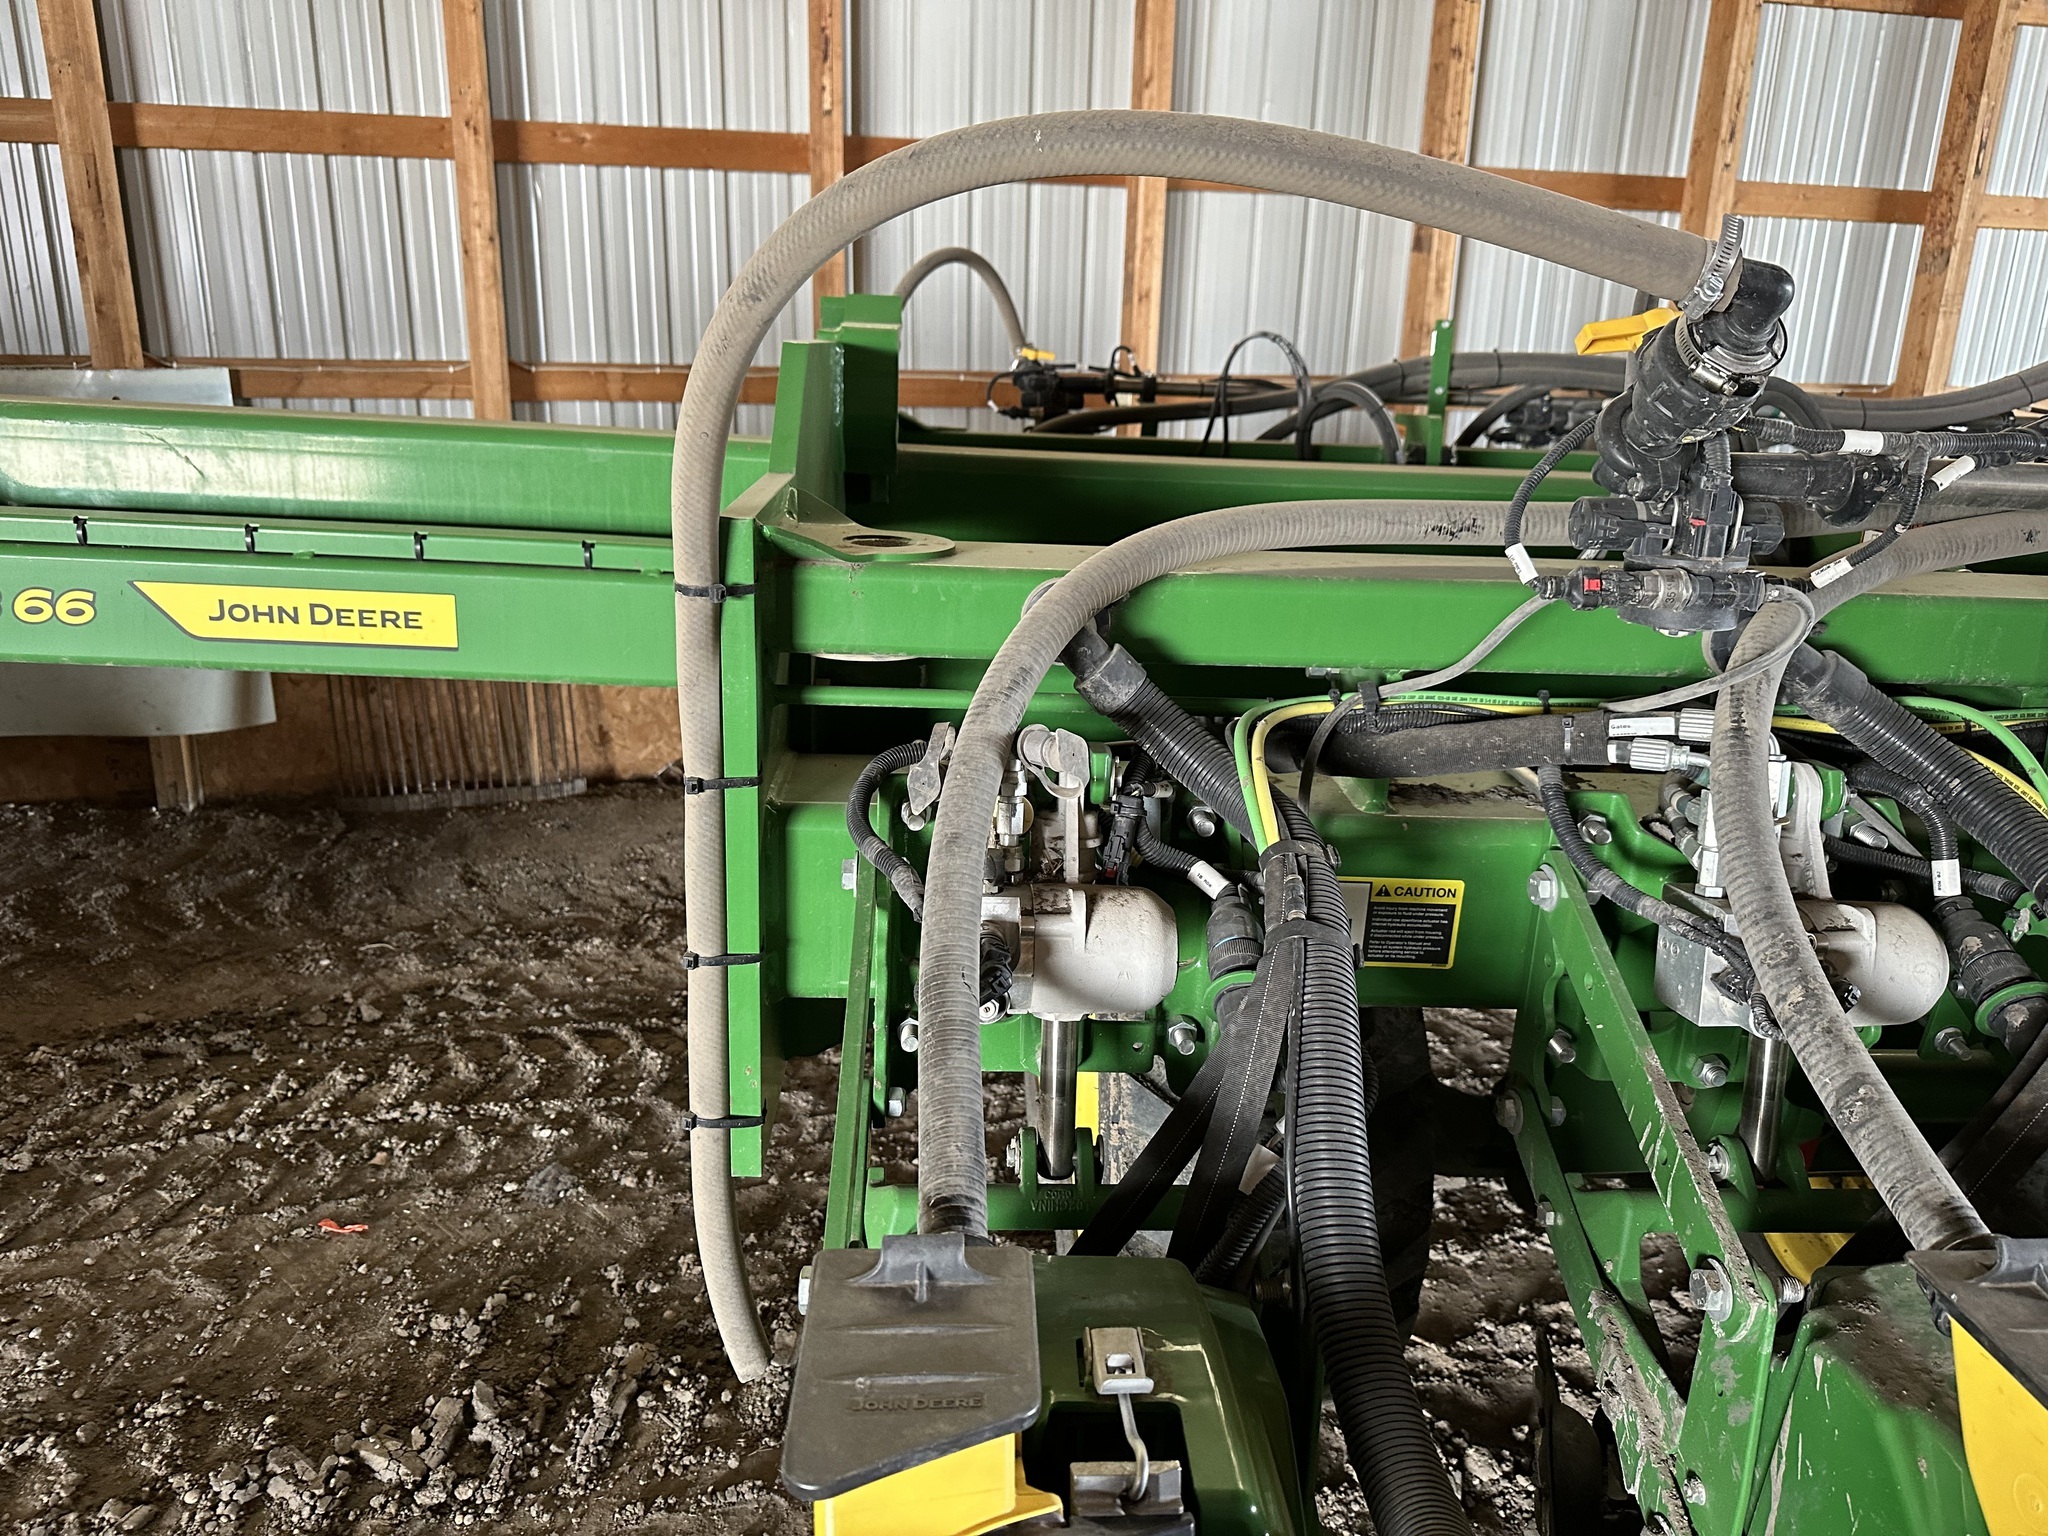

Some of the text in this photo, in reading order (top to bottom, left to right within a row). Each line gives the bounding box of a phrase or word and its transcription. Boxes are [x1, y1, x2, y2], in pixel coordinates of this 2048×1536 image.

[12, 586, 97, 626] 66
[208, 598, 423, 630] JOHN DEERE
[1394, 886, 1457, 898] CAUTION
[850, 1394, 983, 1410] JOHN DEERE
